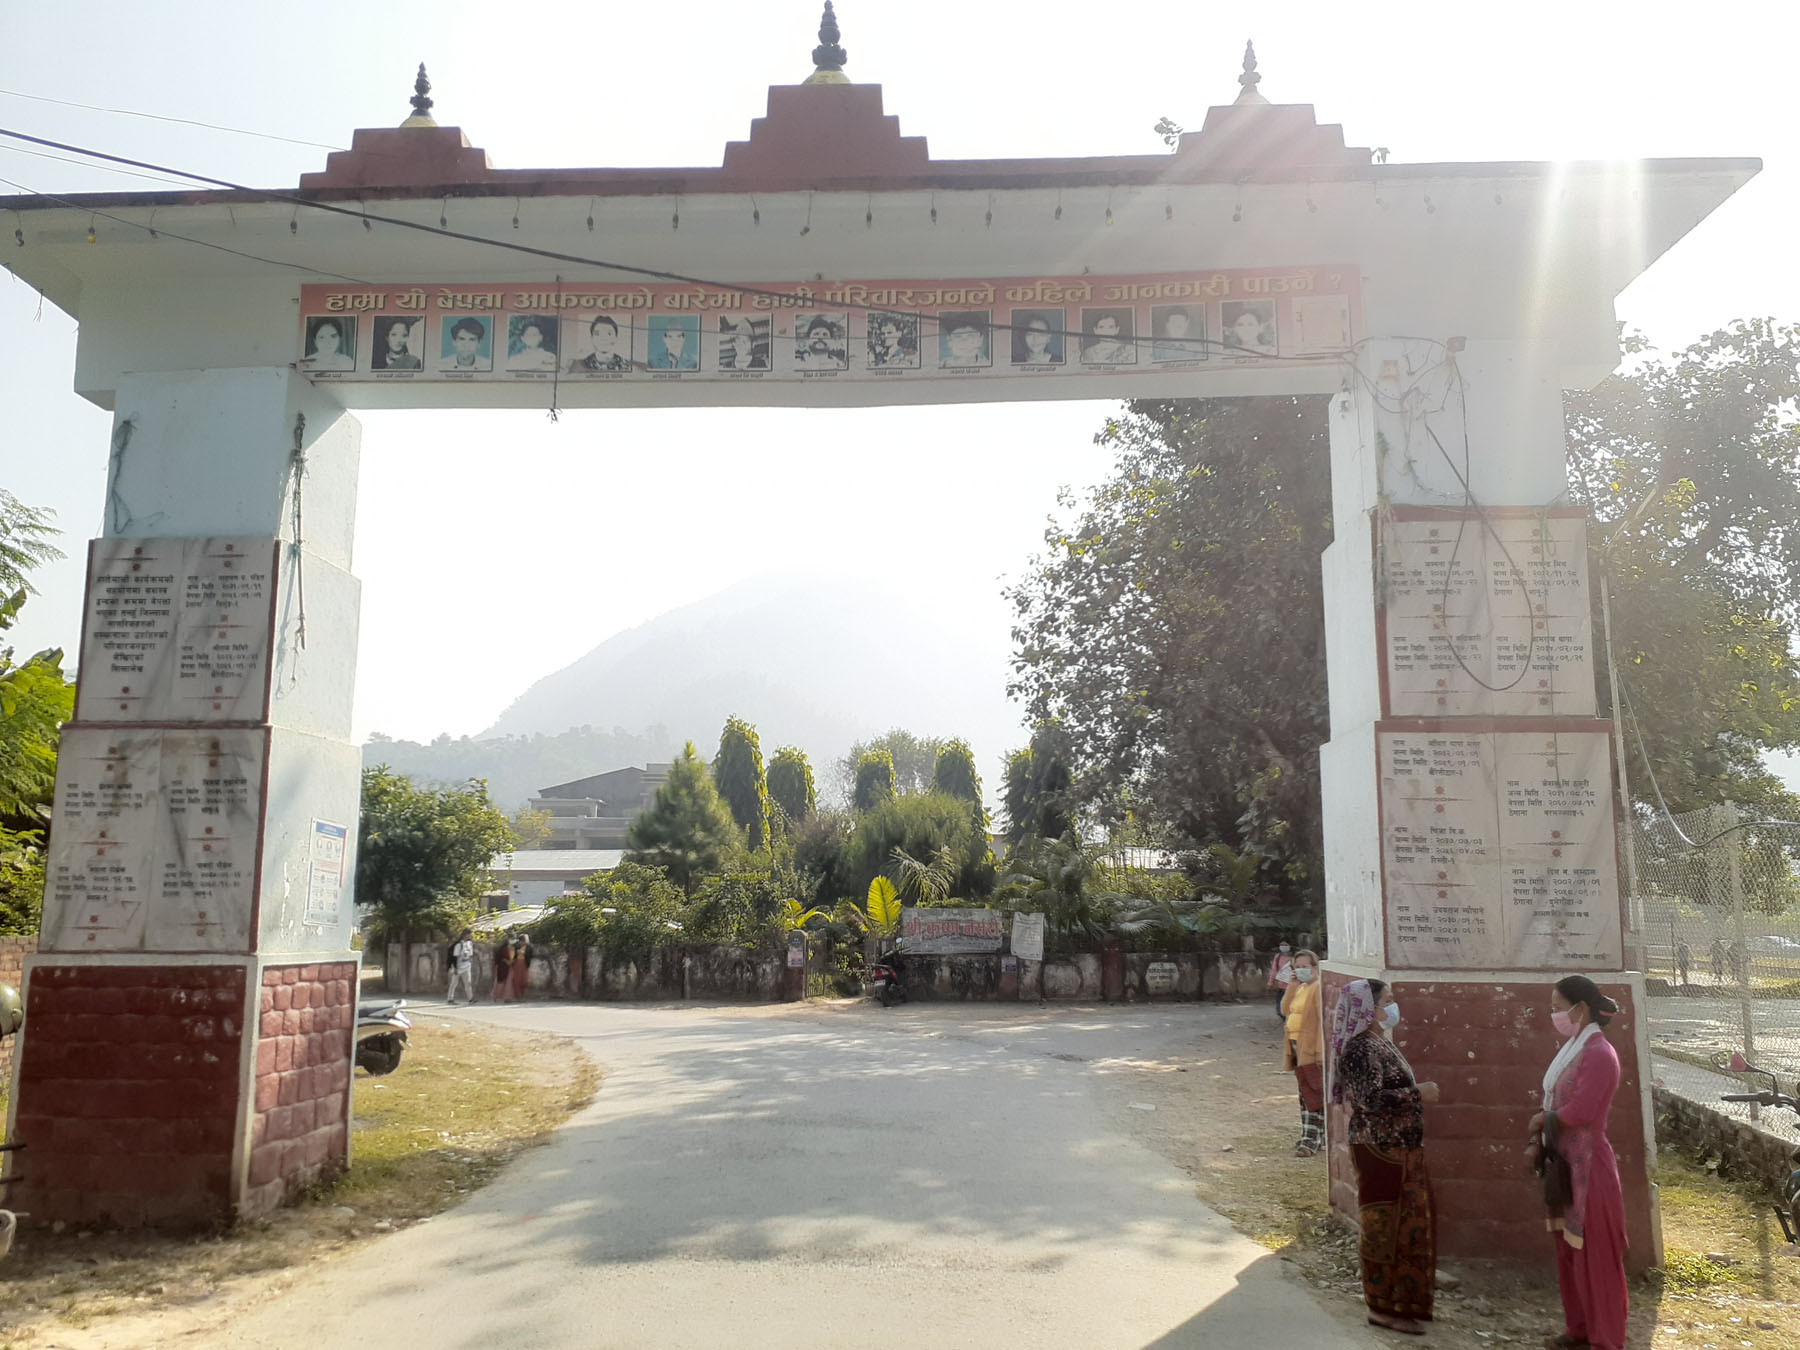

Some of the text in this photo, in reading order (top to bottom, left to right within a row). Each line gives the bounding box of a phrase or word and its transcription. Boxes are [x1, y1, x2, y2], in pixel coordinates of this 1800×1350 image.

[325, 292, 386, 312] हाम्रा
[436, 288, 505, 311] बेपत्ता
[513, 286, 656, 310] आफन्तको
[663, 287, 744, 310] बारेमा
[751, 286, 815, 309] हामी
[825, 282, 996, 309] परिवारजनले
[1005, 279, 1094, 305] कहिले
[1103, 275, 1232, 302] जानकारी
[1242, 269, 1317, 296] पाउने
